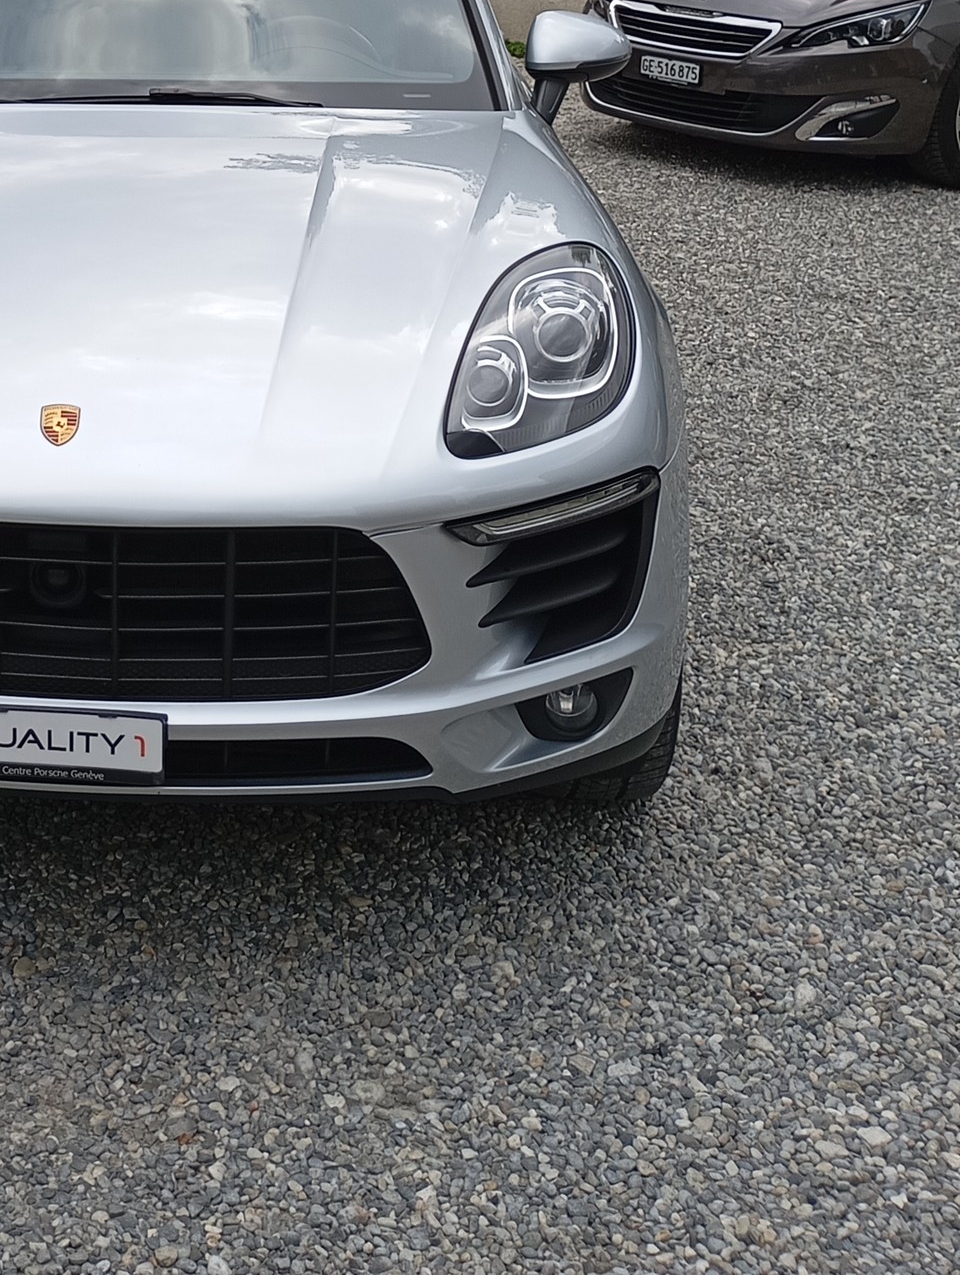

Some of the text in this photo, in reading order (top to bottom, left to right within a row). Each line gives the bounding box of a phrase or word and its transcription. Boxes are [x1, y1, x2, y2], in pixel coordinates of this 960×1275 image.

[2, 765, 105, 781] Centre Porsche Genève
